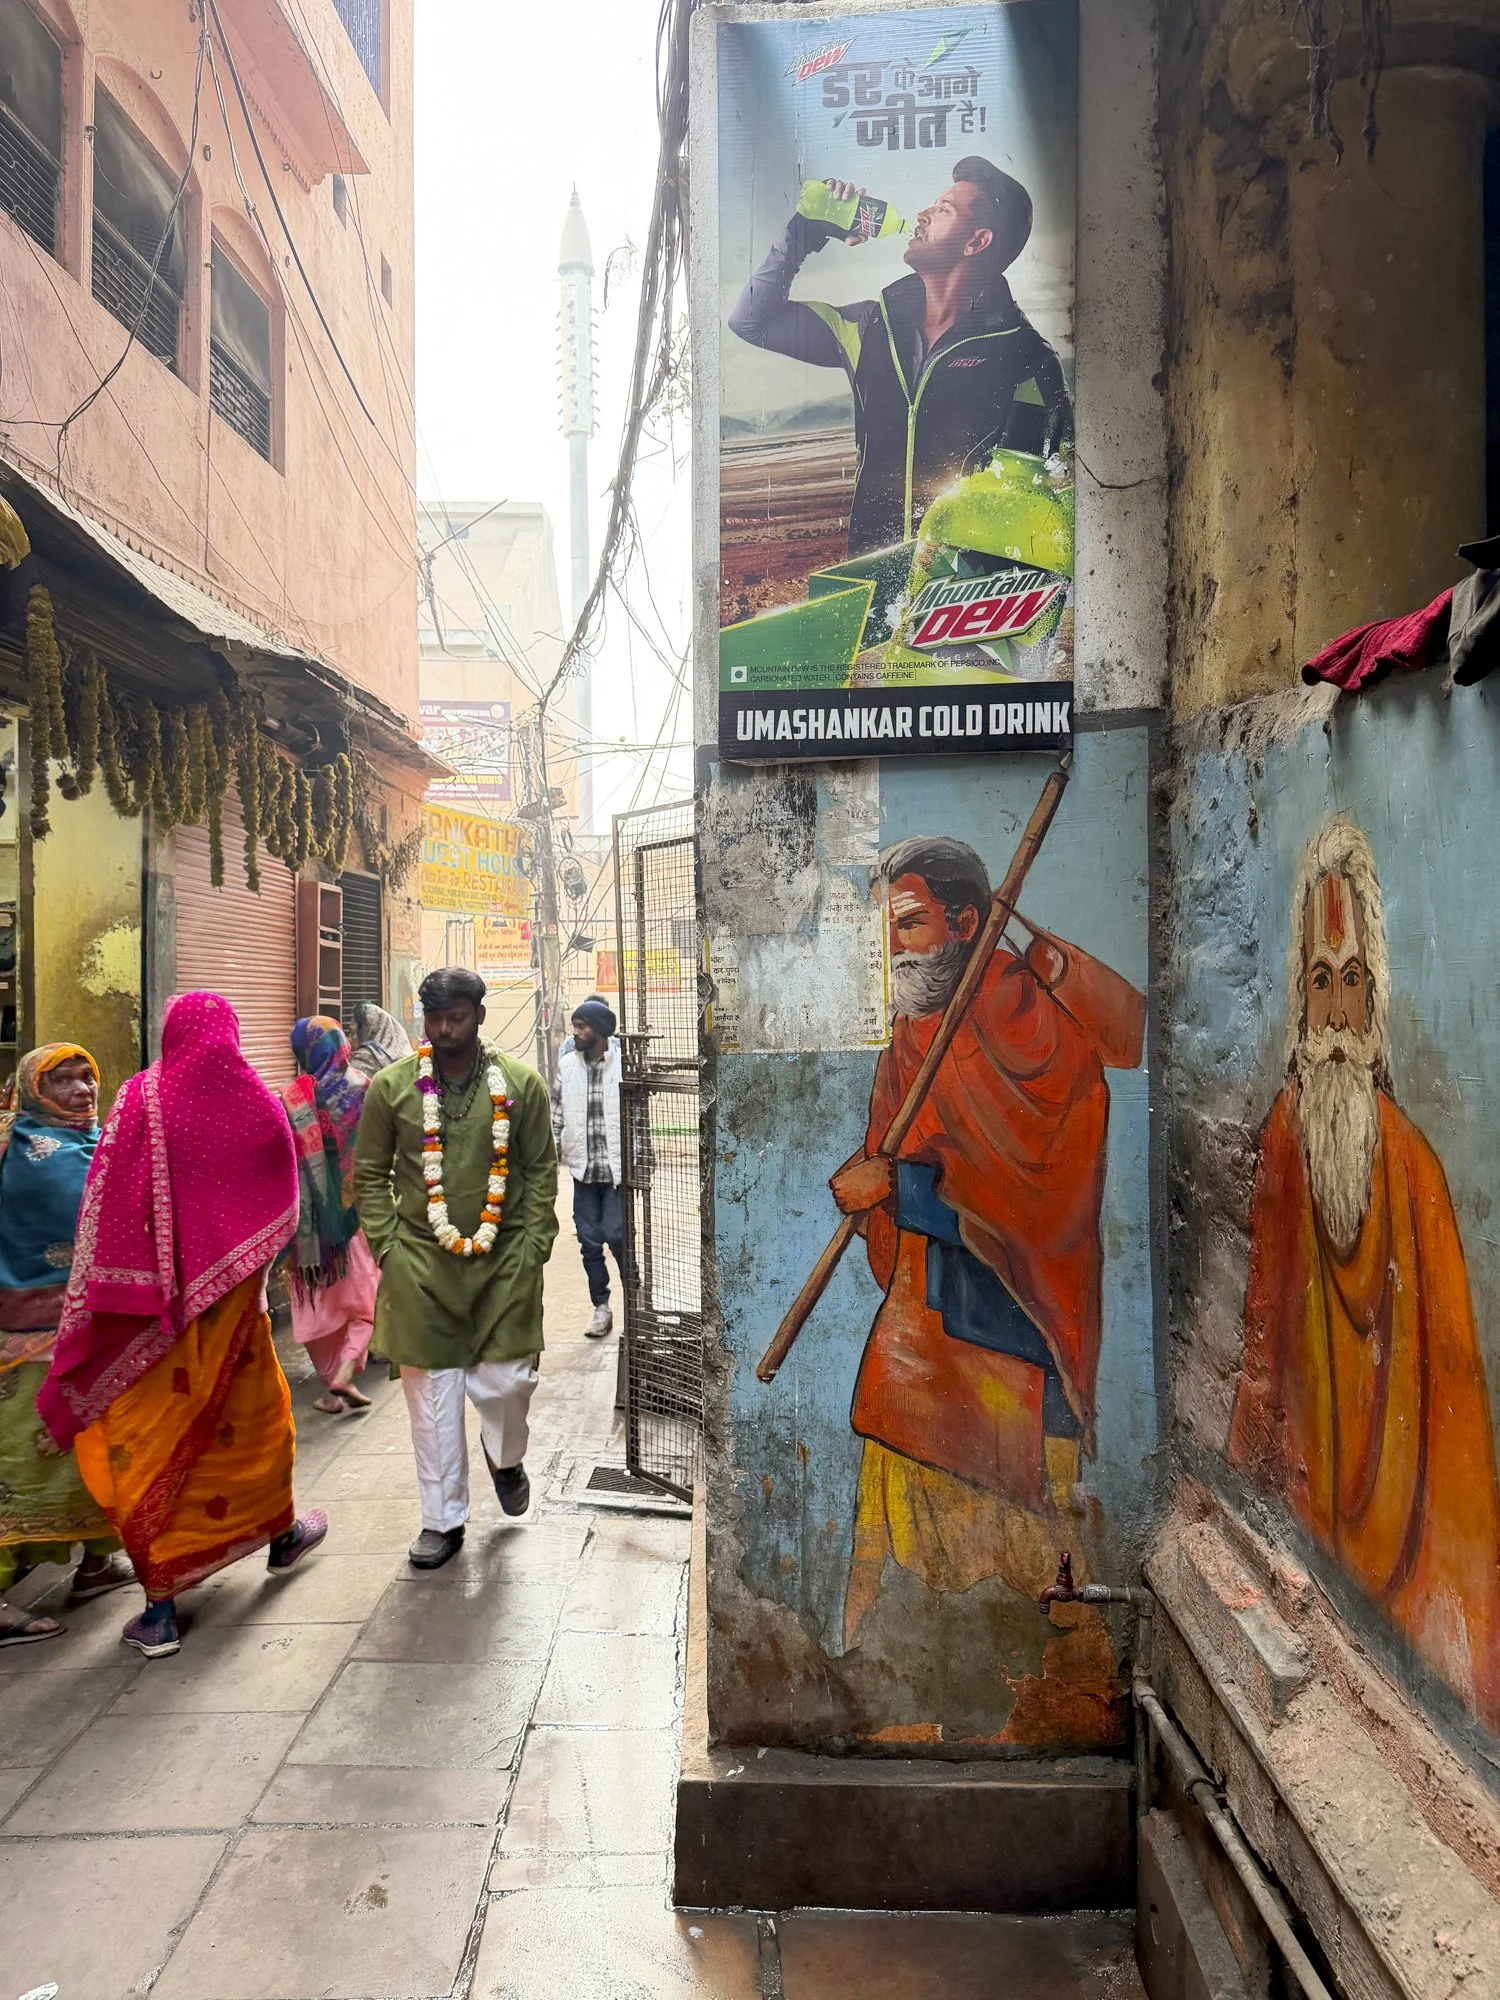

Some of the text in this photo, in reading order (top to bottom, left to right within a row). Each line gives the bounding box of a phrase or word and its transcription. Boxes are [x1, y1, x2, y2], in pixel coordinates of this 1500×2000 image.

[787, 38, 842, 71] Mountain
[822, 57, 984, 108] डर के आगे
[848, 93, 957, 150] जीत
[908, 571, 1044, 614] Mountain
[750, 665, 790, 674] MOUNTAIN
[791, 664, 810, 672] DEW
[820, 663, 835, 671] THE
[837, 661, 886, 671] REGISTERED
[888, 660, 936, 669] TRADEMARK
[937, 660, 949, 668] OF
[750, 675, 802, 683] CARBONATED
[835, 672, 875, 681] CONTAINS
[876, 671, 914, 680] CAFFEINE
[736, 701, 1071, 741] UMASHANKAR COLD DRINK
